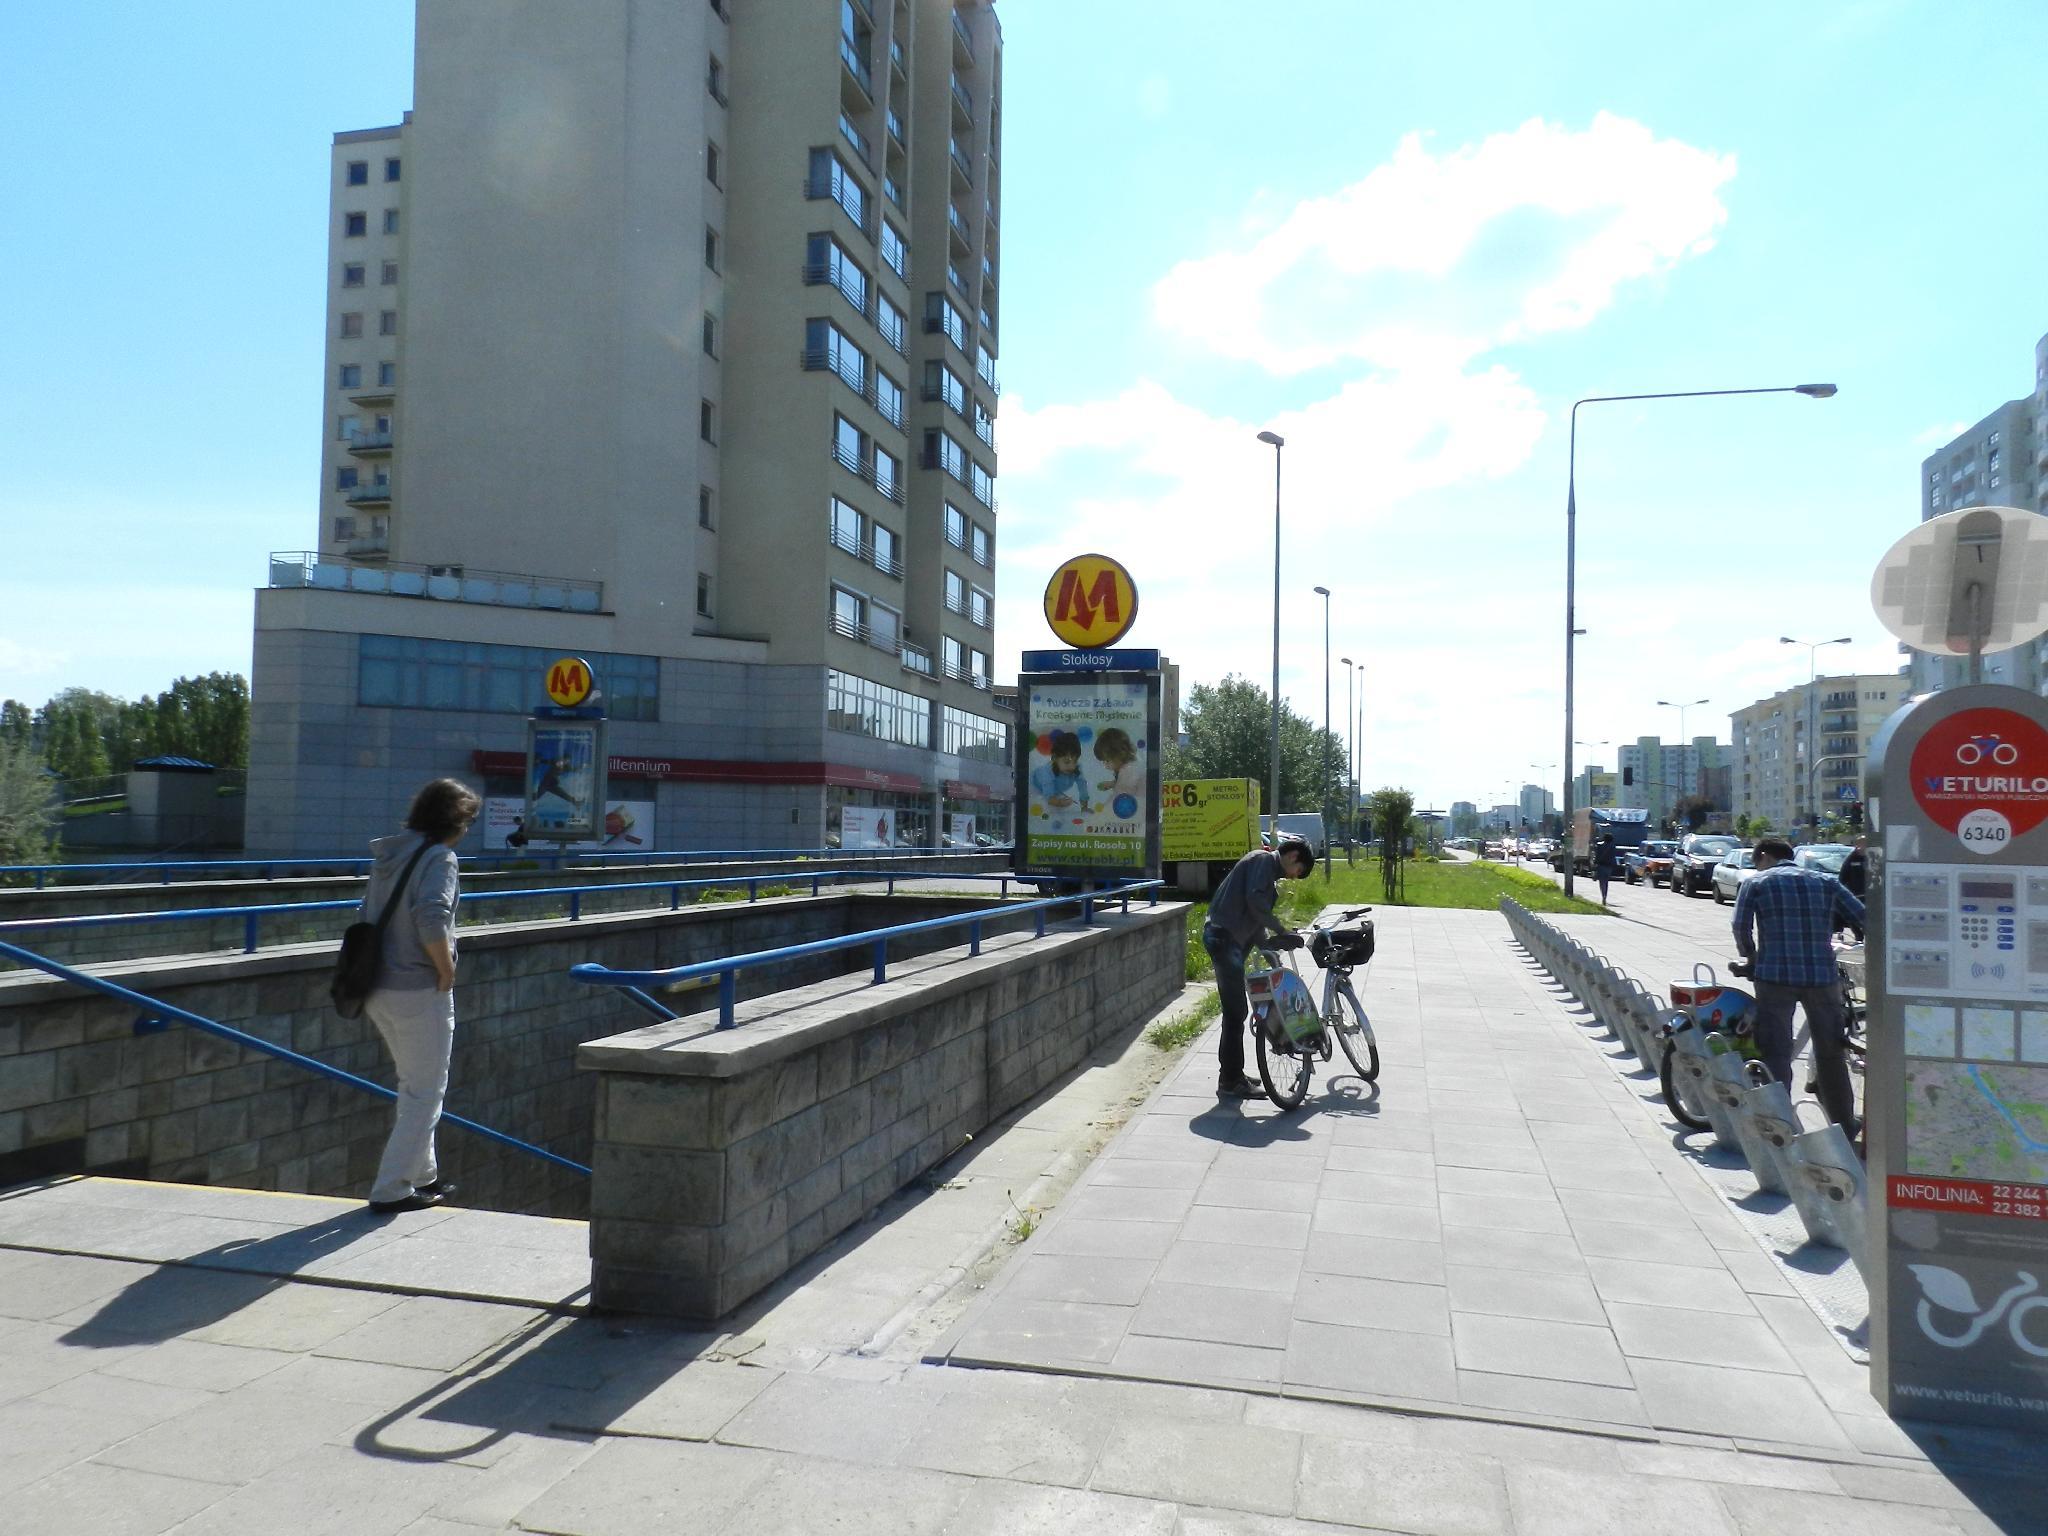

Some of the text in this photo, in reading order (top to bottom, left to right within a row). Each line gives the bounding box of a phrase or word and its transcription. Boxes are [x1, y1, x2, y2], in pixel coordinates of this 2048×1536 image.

[1062, 653, 1113, 667] Stokłosy
[608, 758, 671, 772] illennium
[1212, 785, 1239, 793] METRO
[1926, 776, 2048, 793] VETURILO
[1162, 783, 1198, 807] RO 6
[1162, 798, 1182, 808] UK
[1963, 826, 2006, 841] 6340
[1032, 838, 1063, 850] Zapisy
[1131, 841, 1142, 850] 10
[1896, 1183, 2041, 1205] INFOLINIA: 22 244
[1992, 1201, 2011, 1214] 22
[2014, 1203, 2041, 1217] 382
